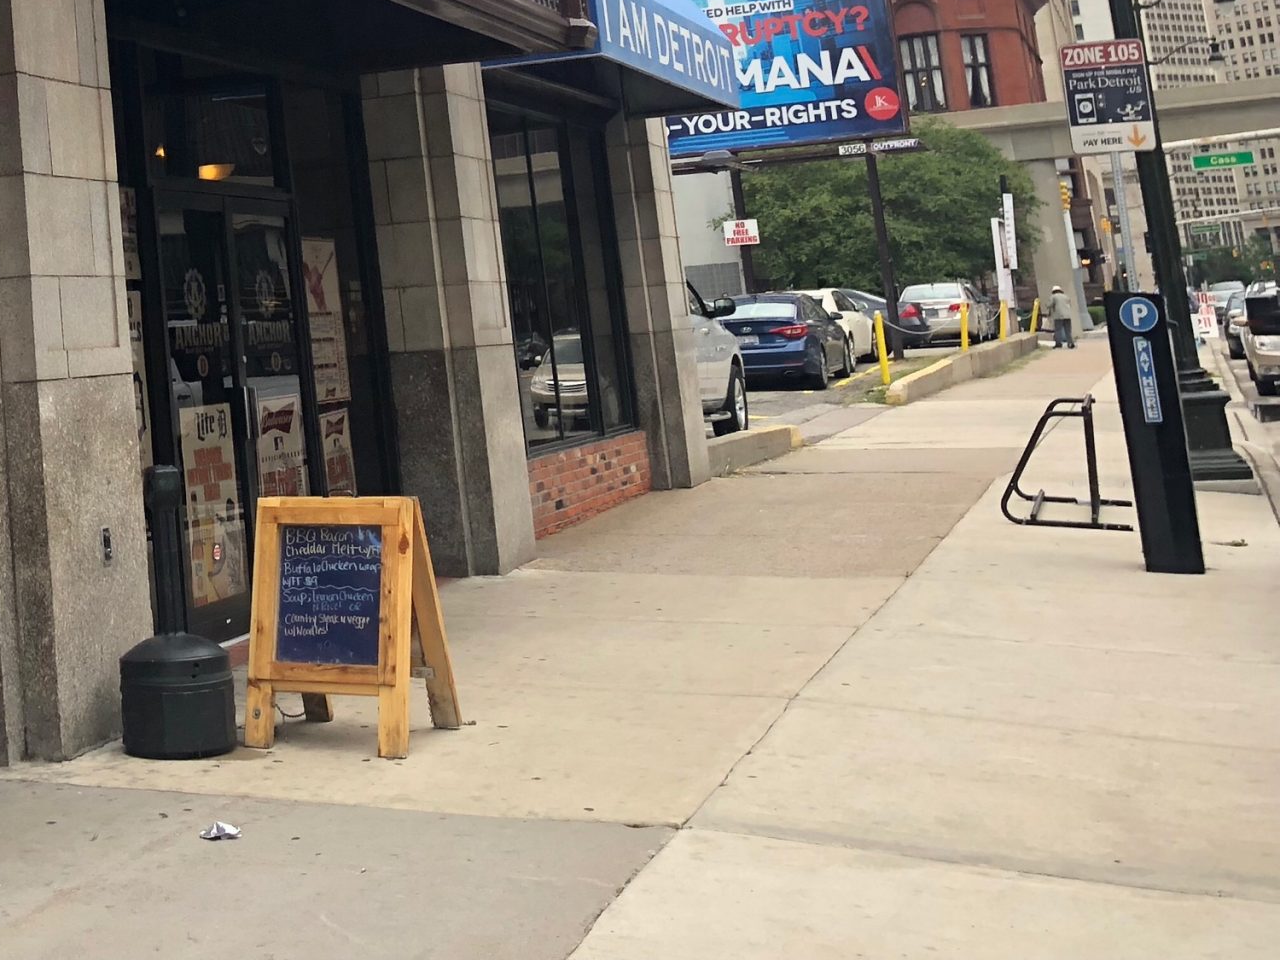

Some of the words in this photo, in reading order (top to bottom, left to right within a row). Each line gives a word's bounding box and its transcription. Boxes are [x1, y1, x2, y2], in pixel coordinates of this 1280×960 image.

[703, 7, 723, 19] ED
[725, 3, 757, 16] HELP
[719, 5, 869, 47] RUPTCY?
[653, 12, 733, 93] DETROIT
[1063, 45, 1105, 66] ZONE
[1107, 43, 1139, 61] 105
[1069, 77, 1096, 90] Park
[1098, 74, 1142, 88] Detroit
[841, 144, 865, 154] 3056
[1083, 138, 1098, 147] PAY
[1101, 137, 1123, 145] HERE
[733, 228, 749, 236] FREE
[735, 221, 745, 229] NO
[726, 235, 758, 245] PARKING
[285, 528, 316, 545] BBQ
[321, 528, 354, 543] Bacon
